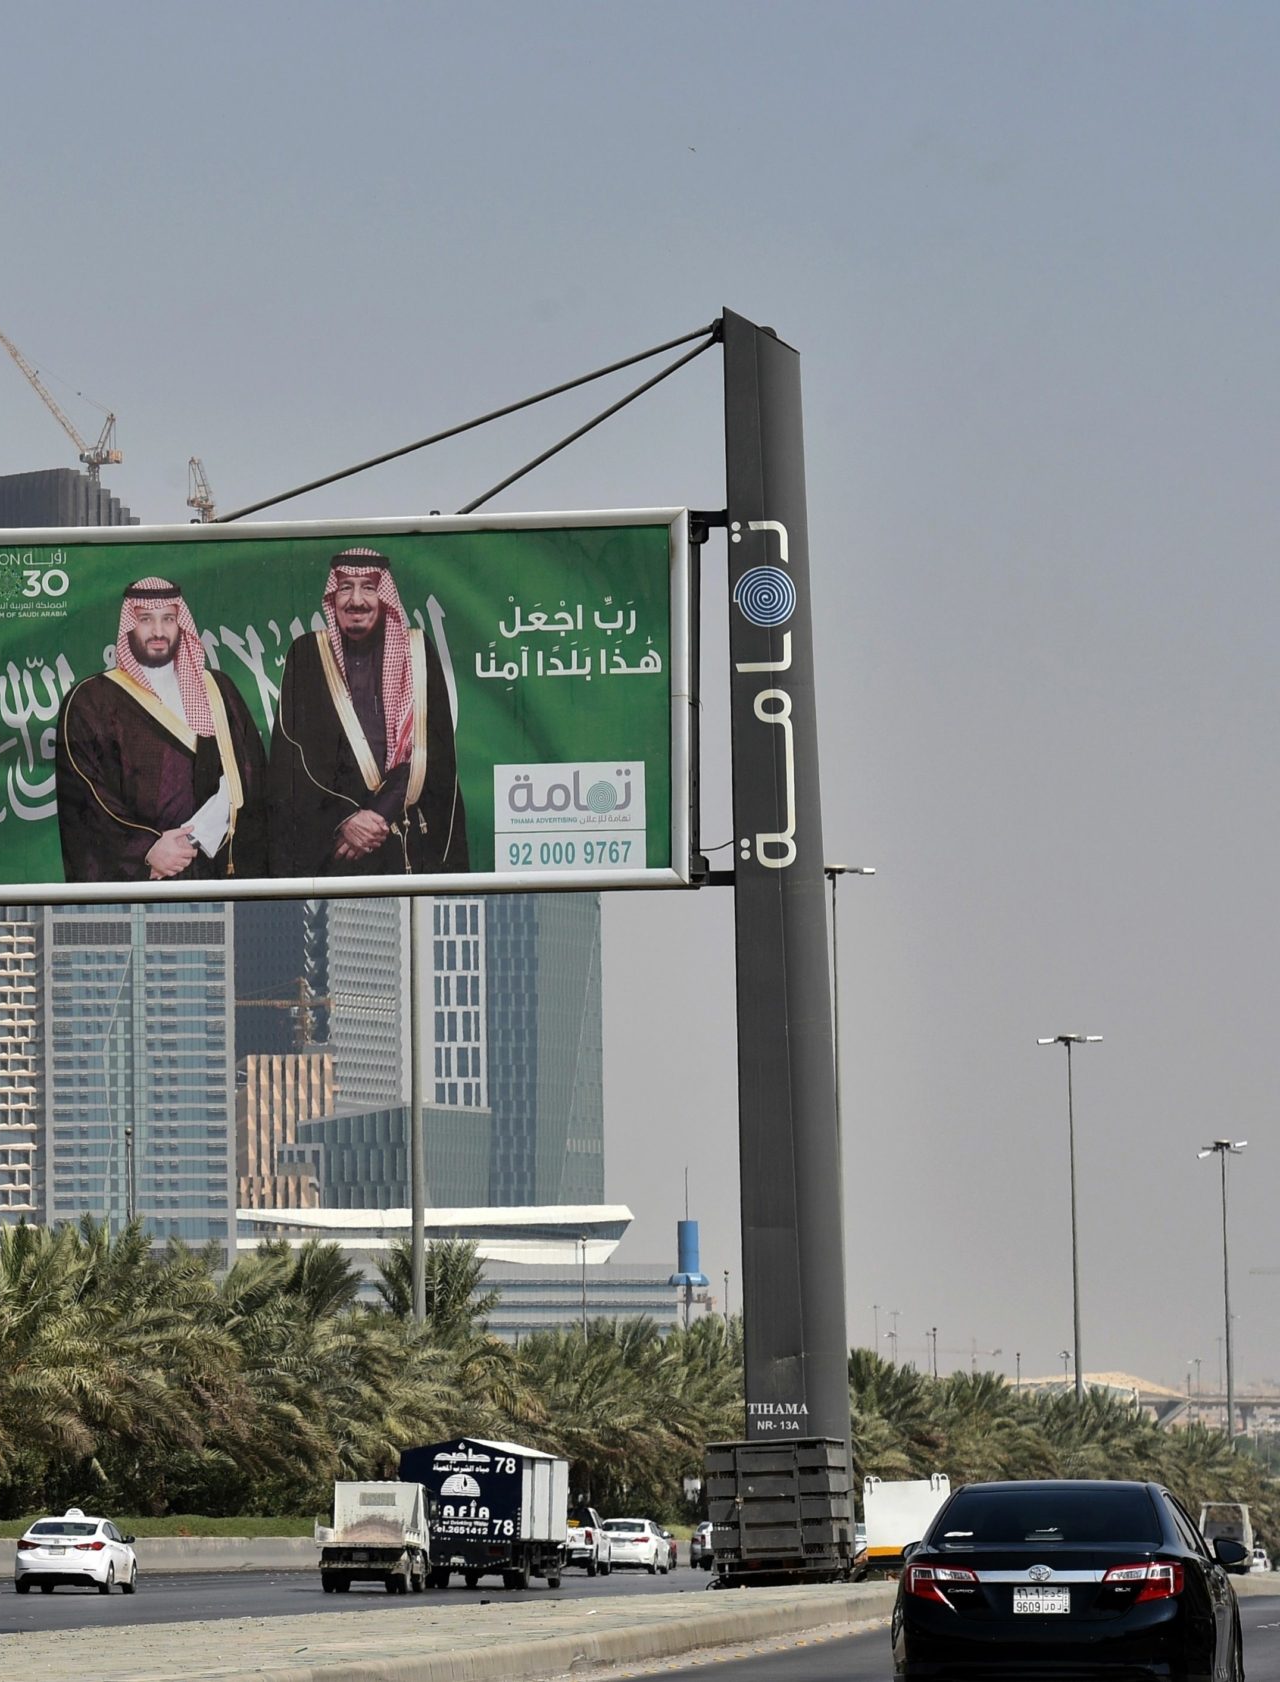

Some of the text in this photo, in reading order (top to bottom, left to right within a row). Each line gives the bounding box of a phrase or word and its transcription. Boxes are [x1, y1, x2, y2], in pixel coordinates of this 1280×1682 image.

[9, 601, 34, 611] العربية
[35, 600, 68, 609] المملكة
[510, 816, 578, 825] TIHAMA ADVERTISING
[509, 840, 632, 866] 92 000 9767
[747, 1402, 810, 1415] TIHAMA
[757, 1420, 800, 1431] NR- 13A
[494, 1456, 516, 1474] 78
[492, 1519, 514, 1536] 78
[1016, 1601, 1041, 1612] 9609
